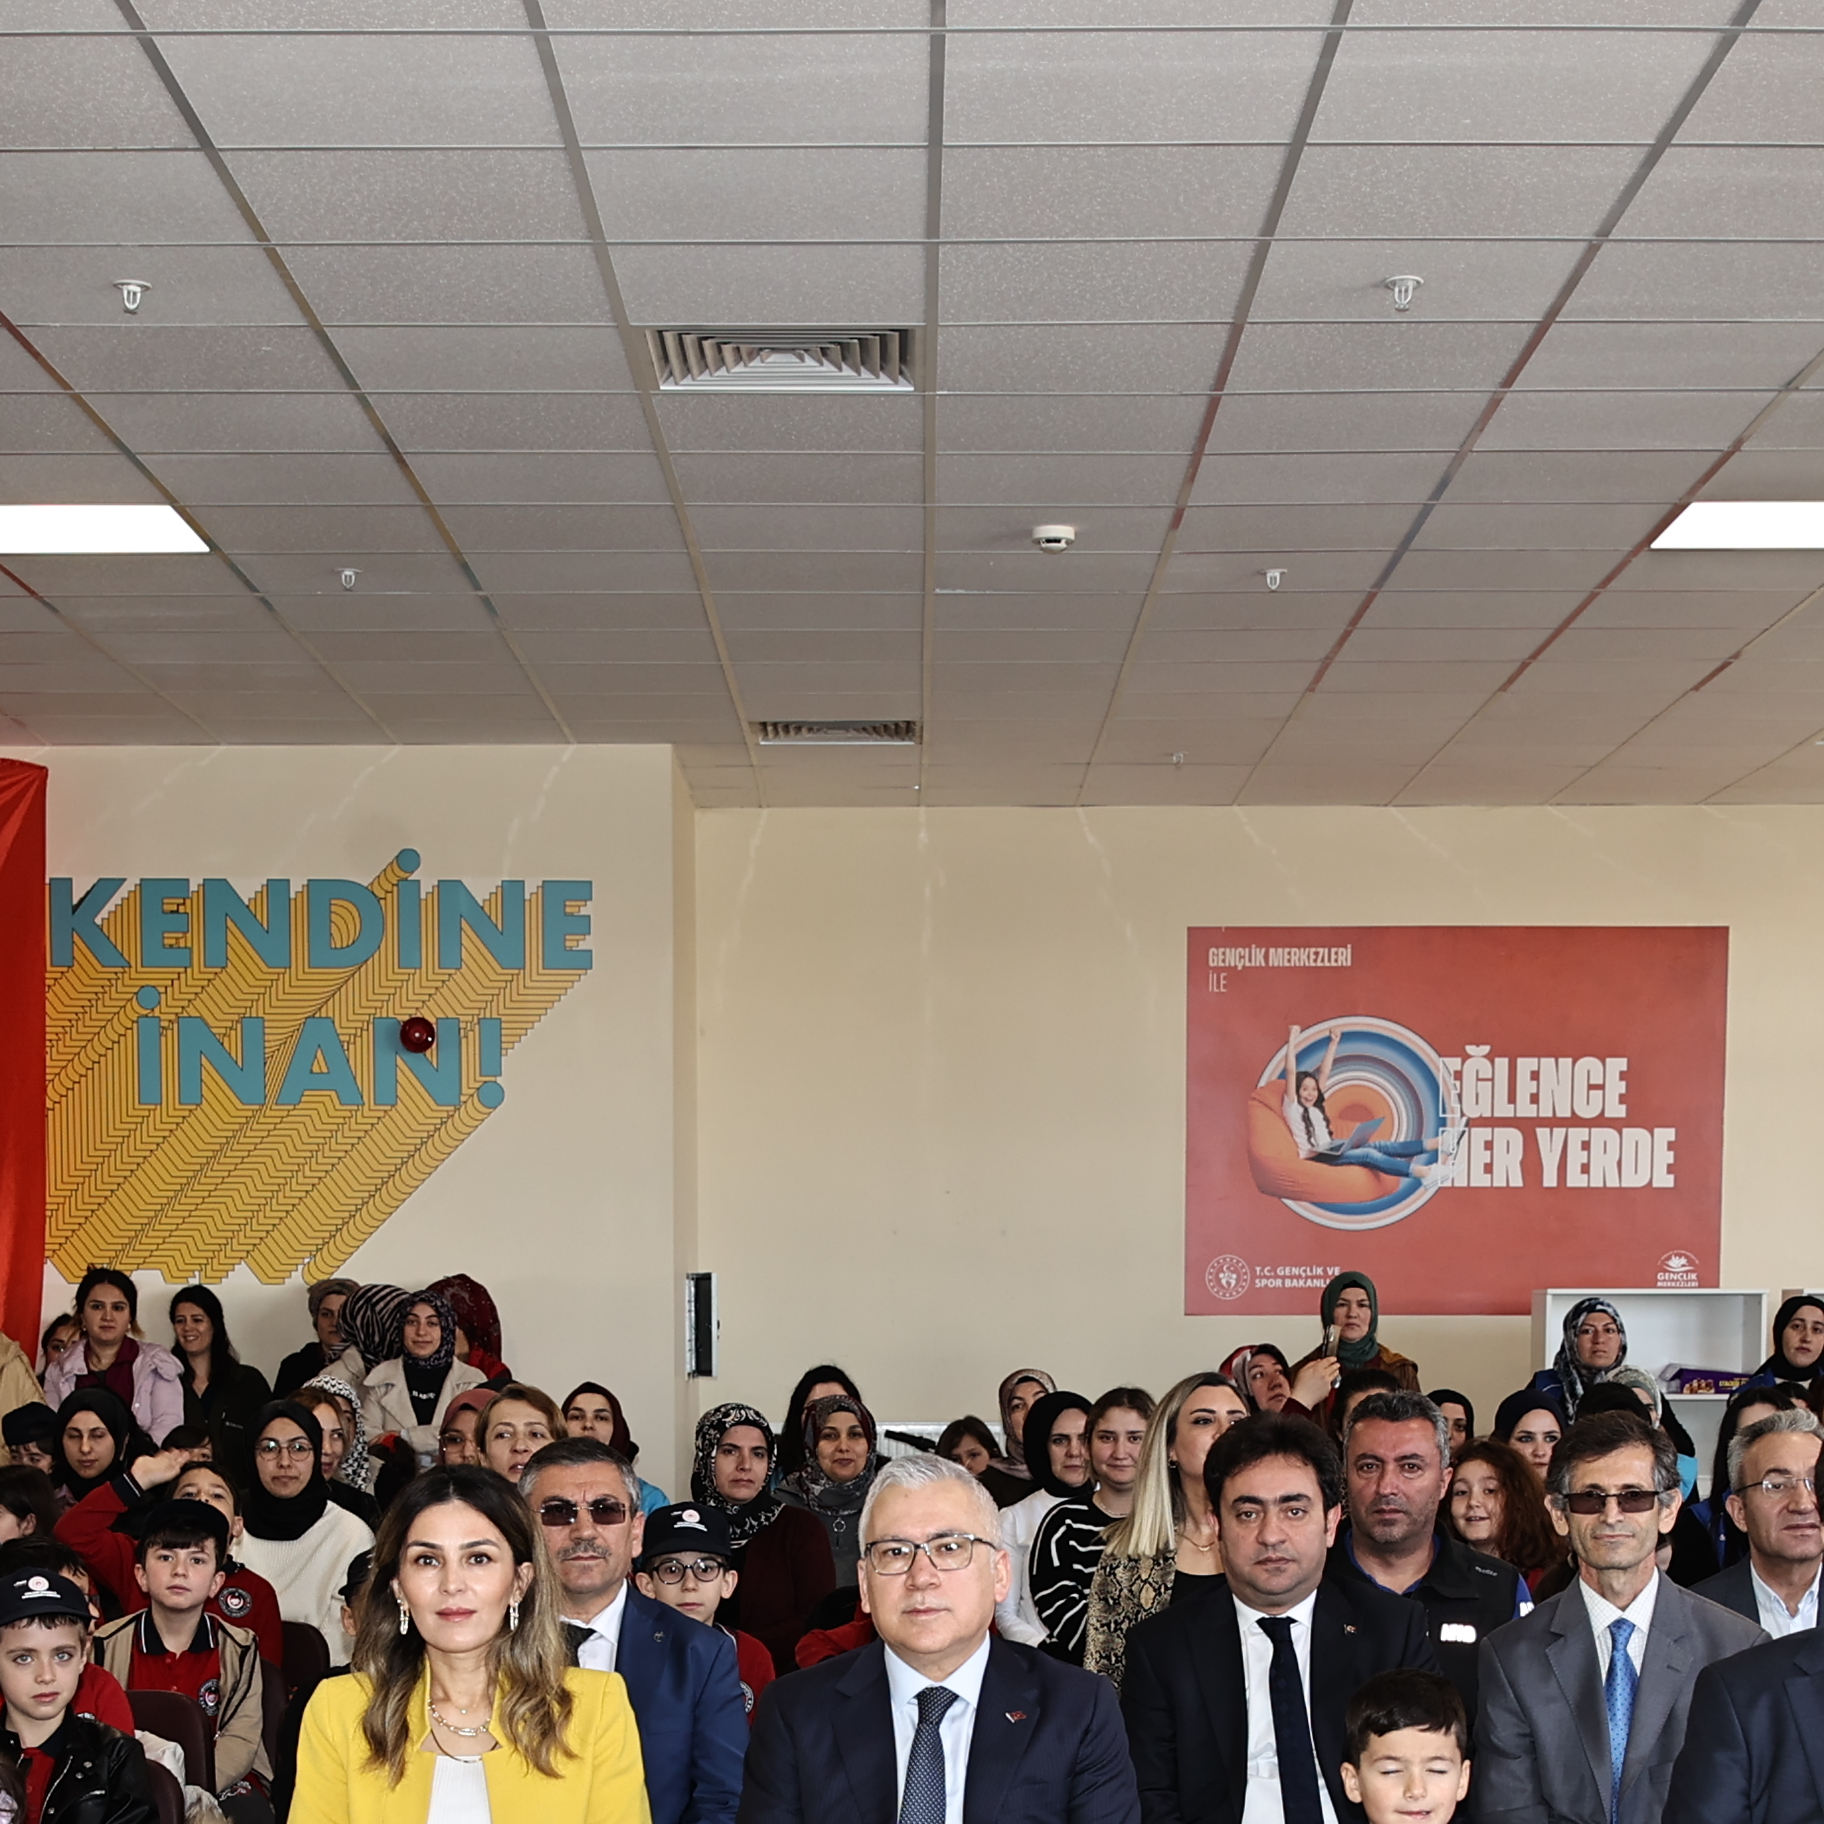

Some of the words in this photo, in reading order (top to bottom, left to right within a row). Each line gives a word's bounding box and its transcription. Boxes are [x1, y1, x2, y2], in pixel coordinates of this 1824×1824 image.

[49, 847, 593, 970] KENDİNE
[1208, 943, 1266, 970] GENÇLİK
[1268, 943, 1352, 967] MERKEZLERİ
[1208, 970, 1227, 992] İLE
[136, 984, 506, 1108] İNAN!
[1439, 1044, 1628, 1119] EĞLENCE
[1438, 1127, 1524, 1188] HER
[1535, 1127, 1676, 1188] YERDE
[1255, 1266, 1274, 1276] T.C.
[1276, 1265, 1324, 1278] GENÇLİK
[1326, 1266, 1342, 1276] VE
[1255, 1279, 1282, 1288] SPOR
[1284, 1279, 1331, 1288] BAKANLI
